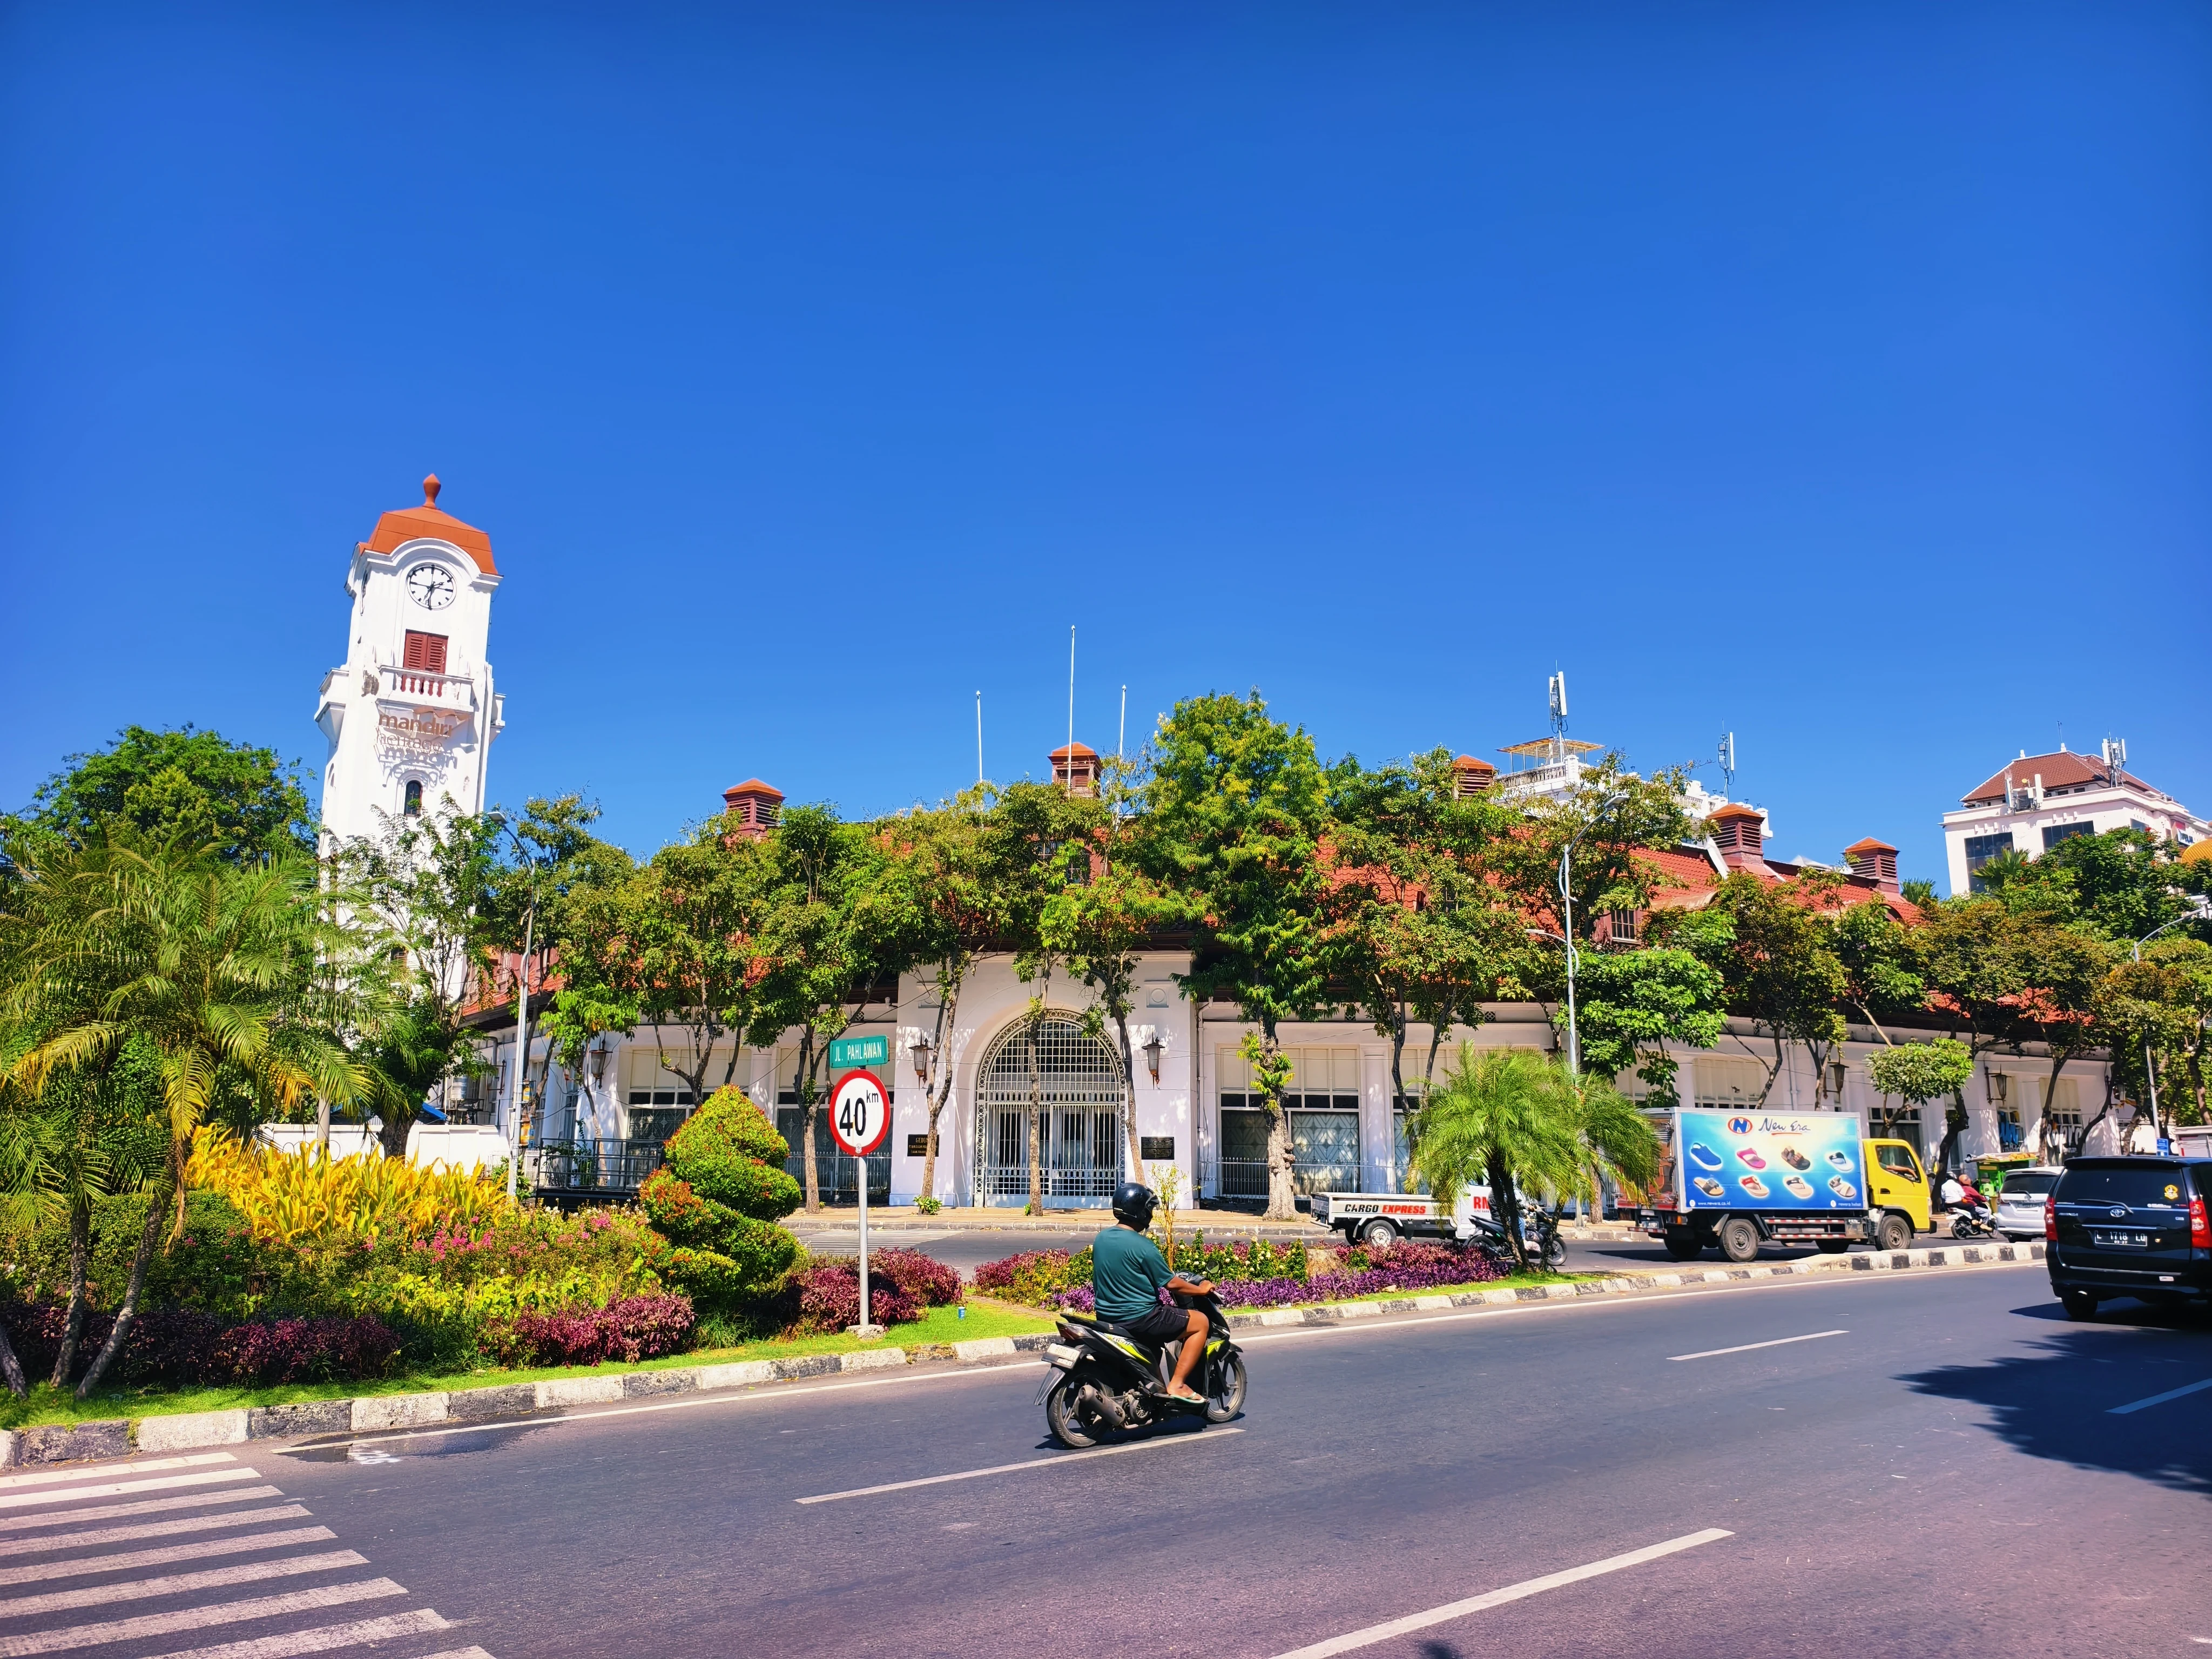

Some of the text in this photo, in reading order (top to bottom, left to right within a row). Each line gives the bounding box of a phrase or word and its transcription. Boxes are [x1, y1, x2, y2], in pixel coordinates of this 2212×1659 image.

[378, 714, 452, 737] mandiri
[376, 726, 442, 754] heritage
[835, 1042, 882, 1061] JL. PAHLAWAN
[839, 1089, 879, 1136] 40 km
[1758, 1117, 1811, 1131] New Era
[1344, 1204, 1426, 1214] CARGO EXPRESS
[2109, 1231, 2128, 1240] 1718
